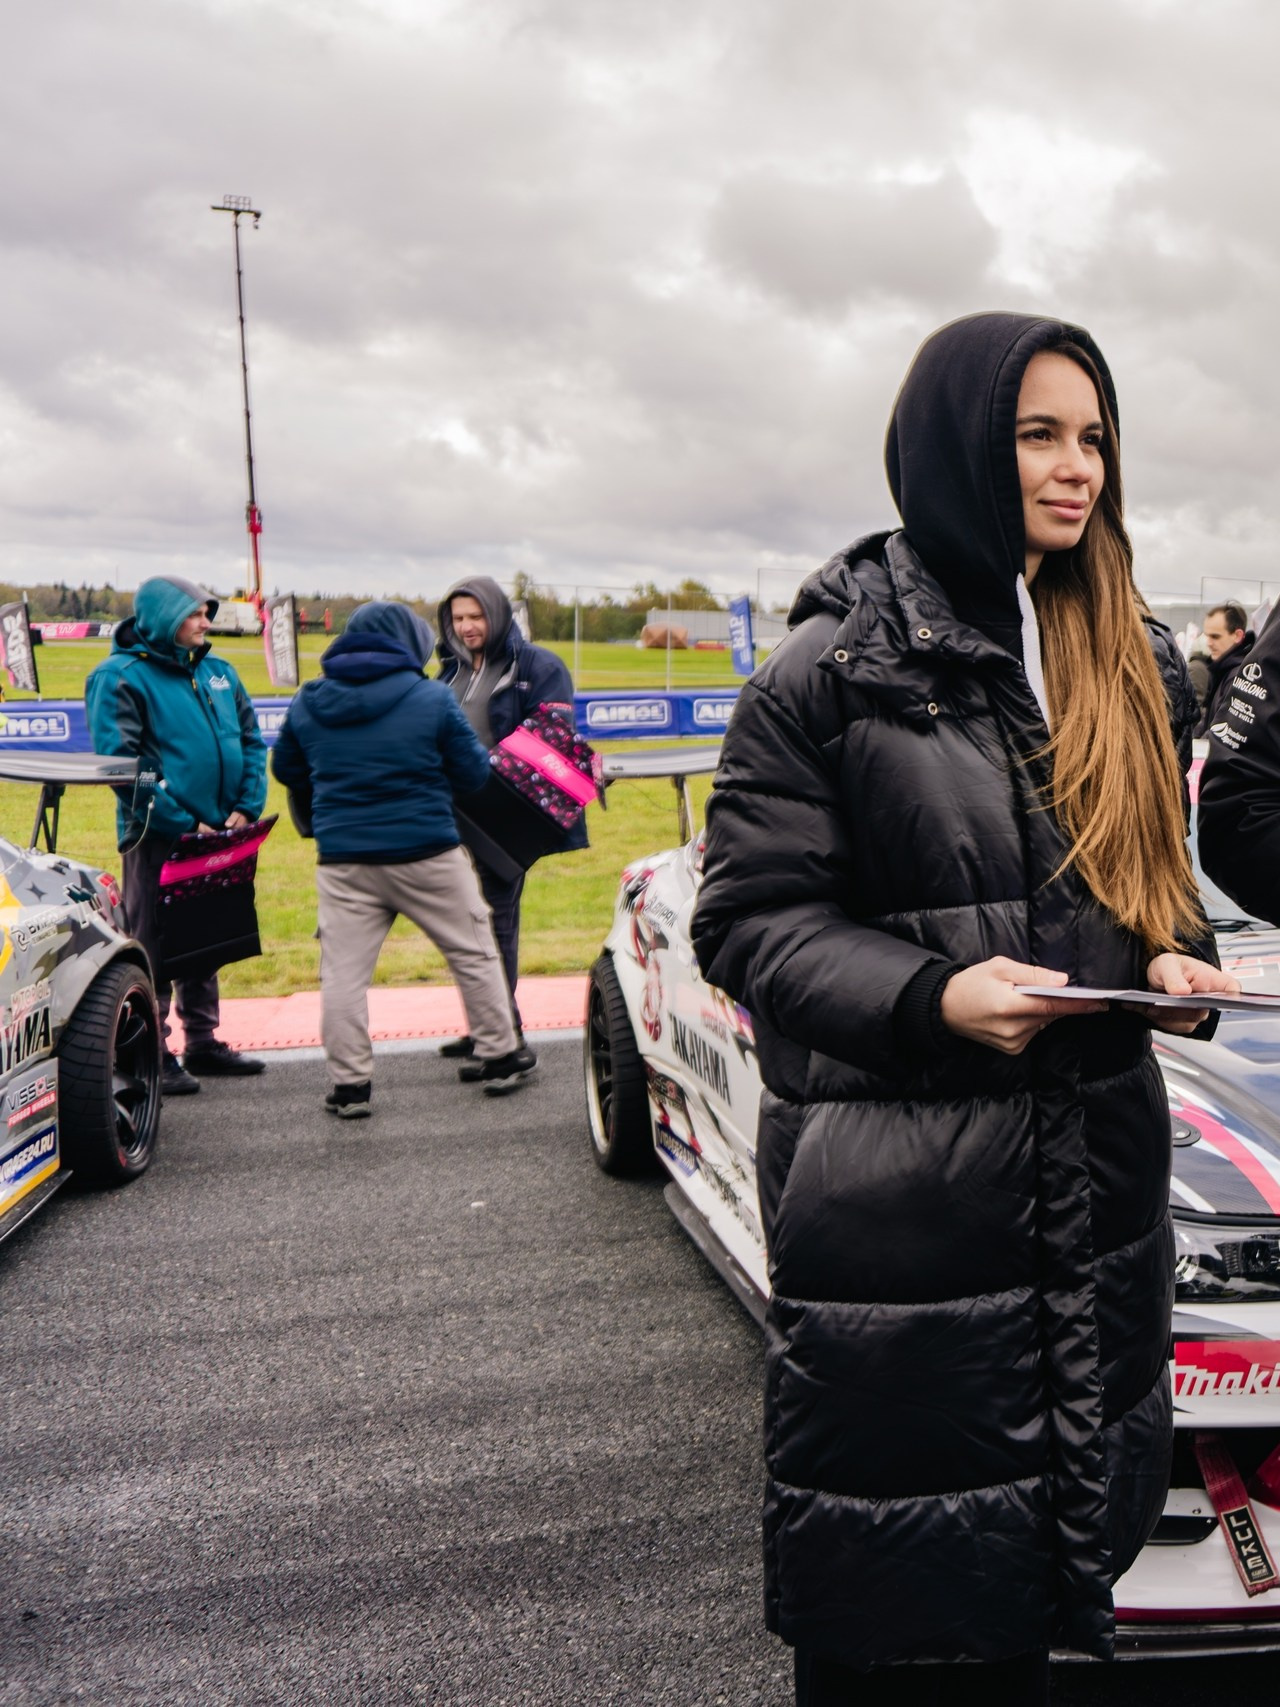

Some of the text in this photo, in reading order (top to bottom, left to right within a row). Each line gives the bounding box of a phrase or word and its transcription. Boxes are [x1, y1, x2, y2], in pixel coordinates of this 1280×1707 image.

[1233, 676, 1267, 700] LINGLONG
[591, 704, 664, 722] AIMOL
[0, 718, 64, 736] MOL
[0, 1006, 52, 1075] YAMA
[1229, 1515, 1265, 1570] LUKE
